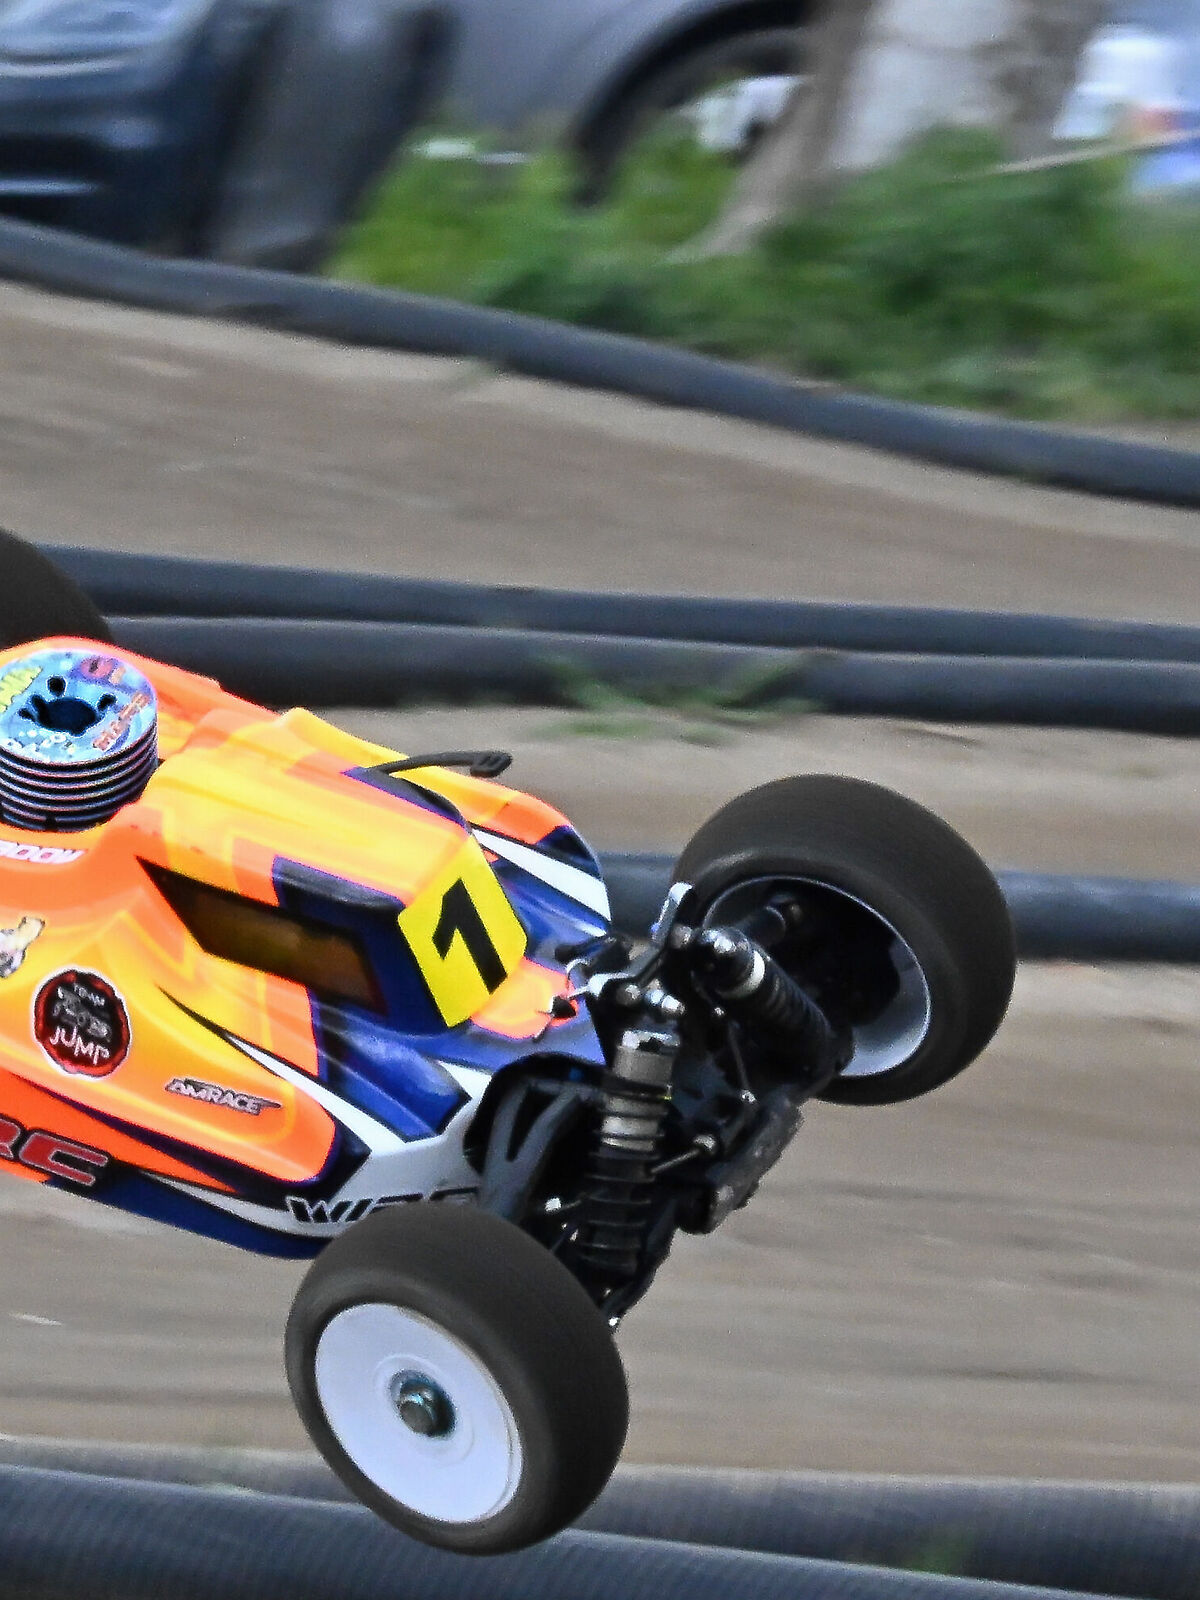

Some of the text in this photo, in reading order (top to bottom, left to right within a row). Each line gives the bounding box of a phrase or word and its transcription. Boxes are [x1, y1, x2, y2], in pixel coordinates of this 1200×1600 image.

[433, 877, 509, 996] 1
[49, 1025, 110, 1066] JUMP
[165, 1080, 261, 1116] AMRACE
[285, 1184, 481, 1225] WI
